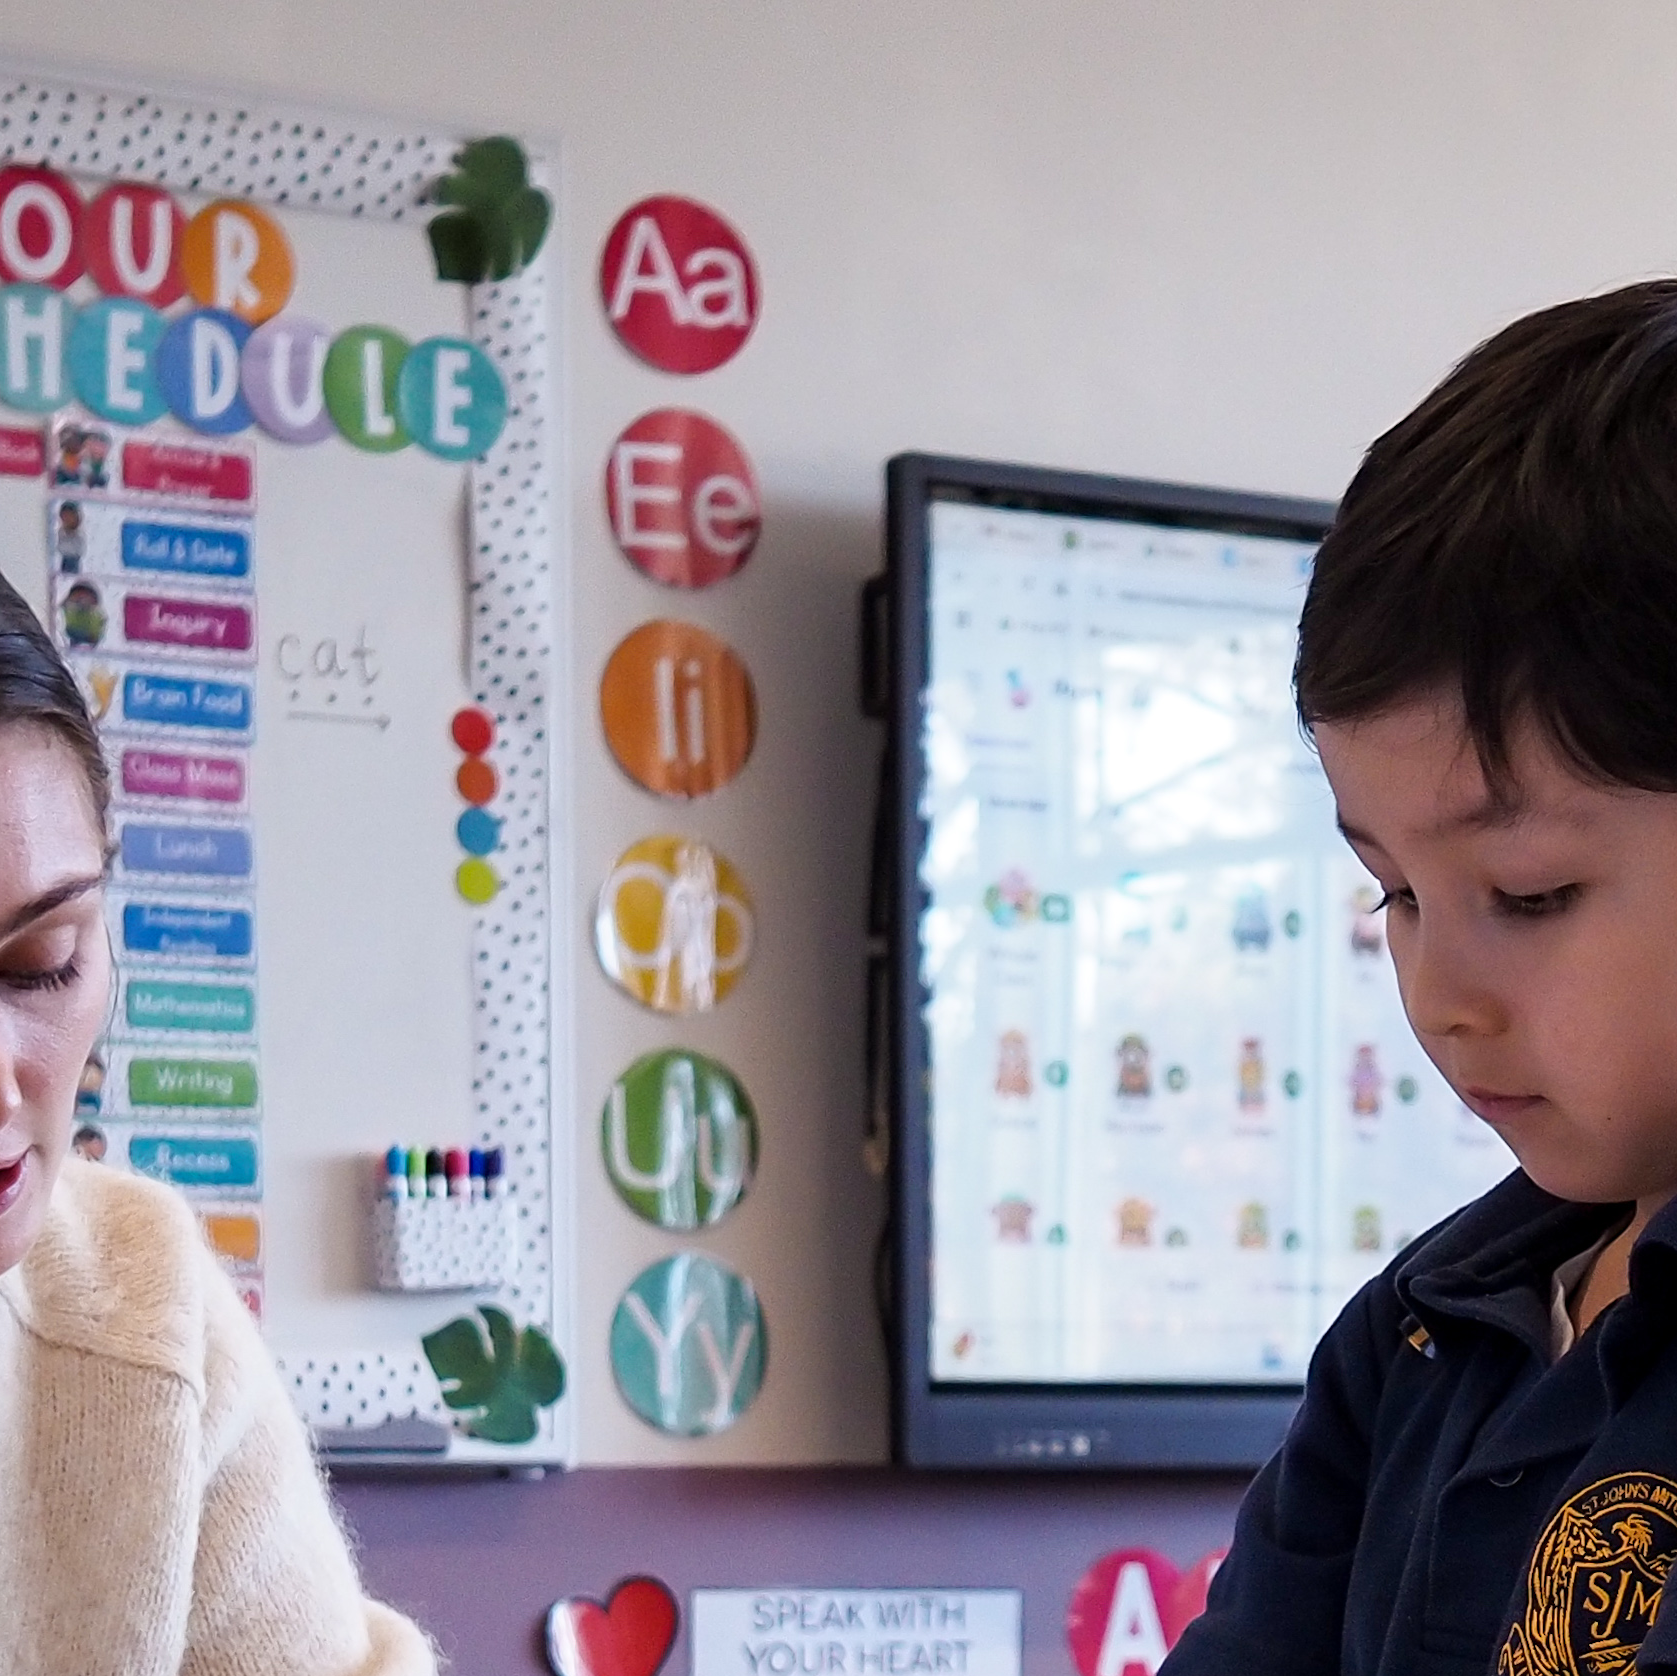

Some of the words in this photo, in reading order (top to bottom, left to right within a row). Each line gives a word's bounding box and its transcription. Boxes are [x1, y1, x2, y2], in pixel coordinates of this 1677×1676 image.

[611, 215, 752, 328] Aa
[615, 441, 754, 556] Ee
[277, 624, 380, 685] cat
[155, 1065, 234, 1098] Writing
[625, 1291, 754, 1428] Yy
[752, 1599, 866, 1632] SPEAK
[876, 1600, 967, 1632] WITH
[742, 1641, 847, 1676] YOUR
[857, 1640, 971, 1675] HEART
